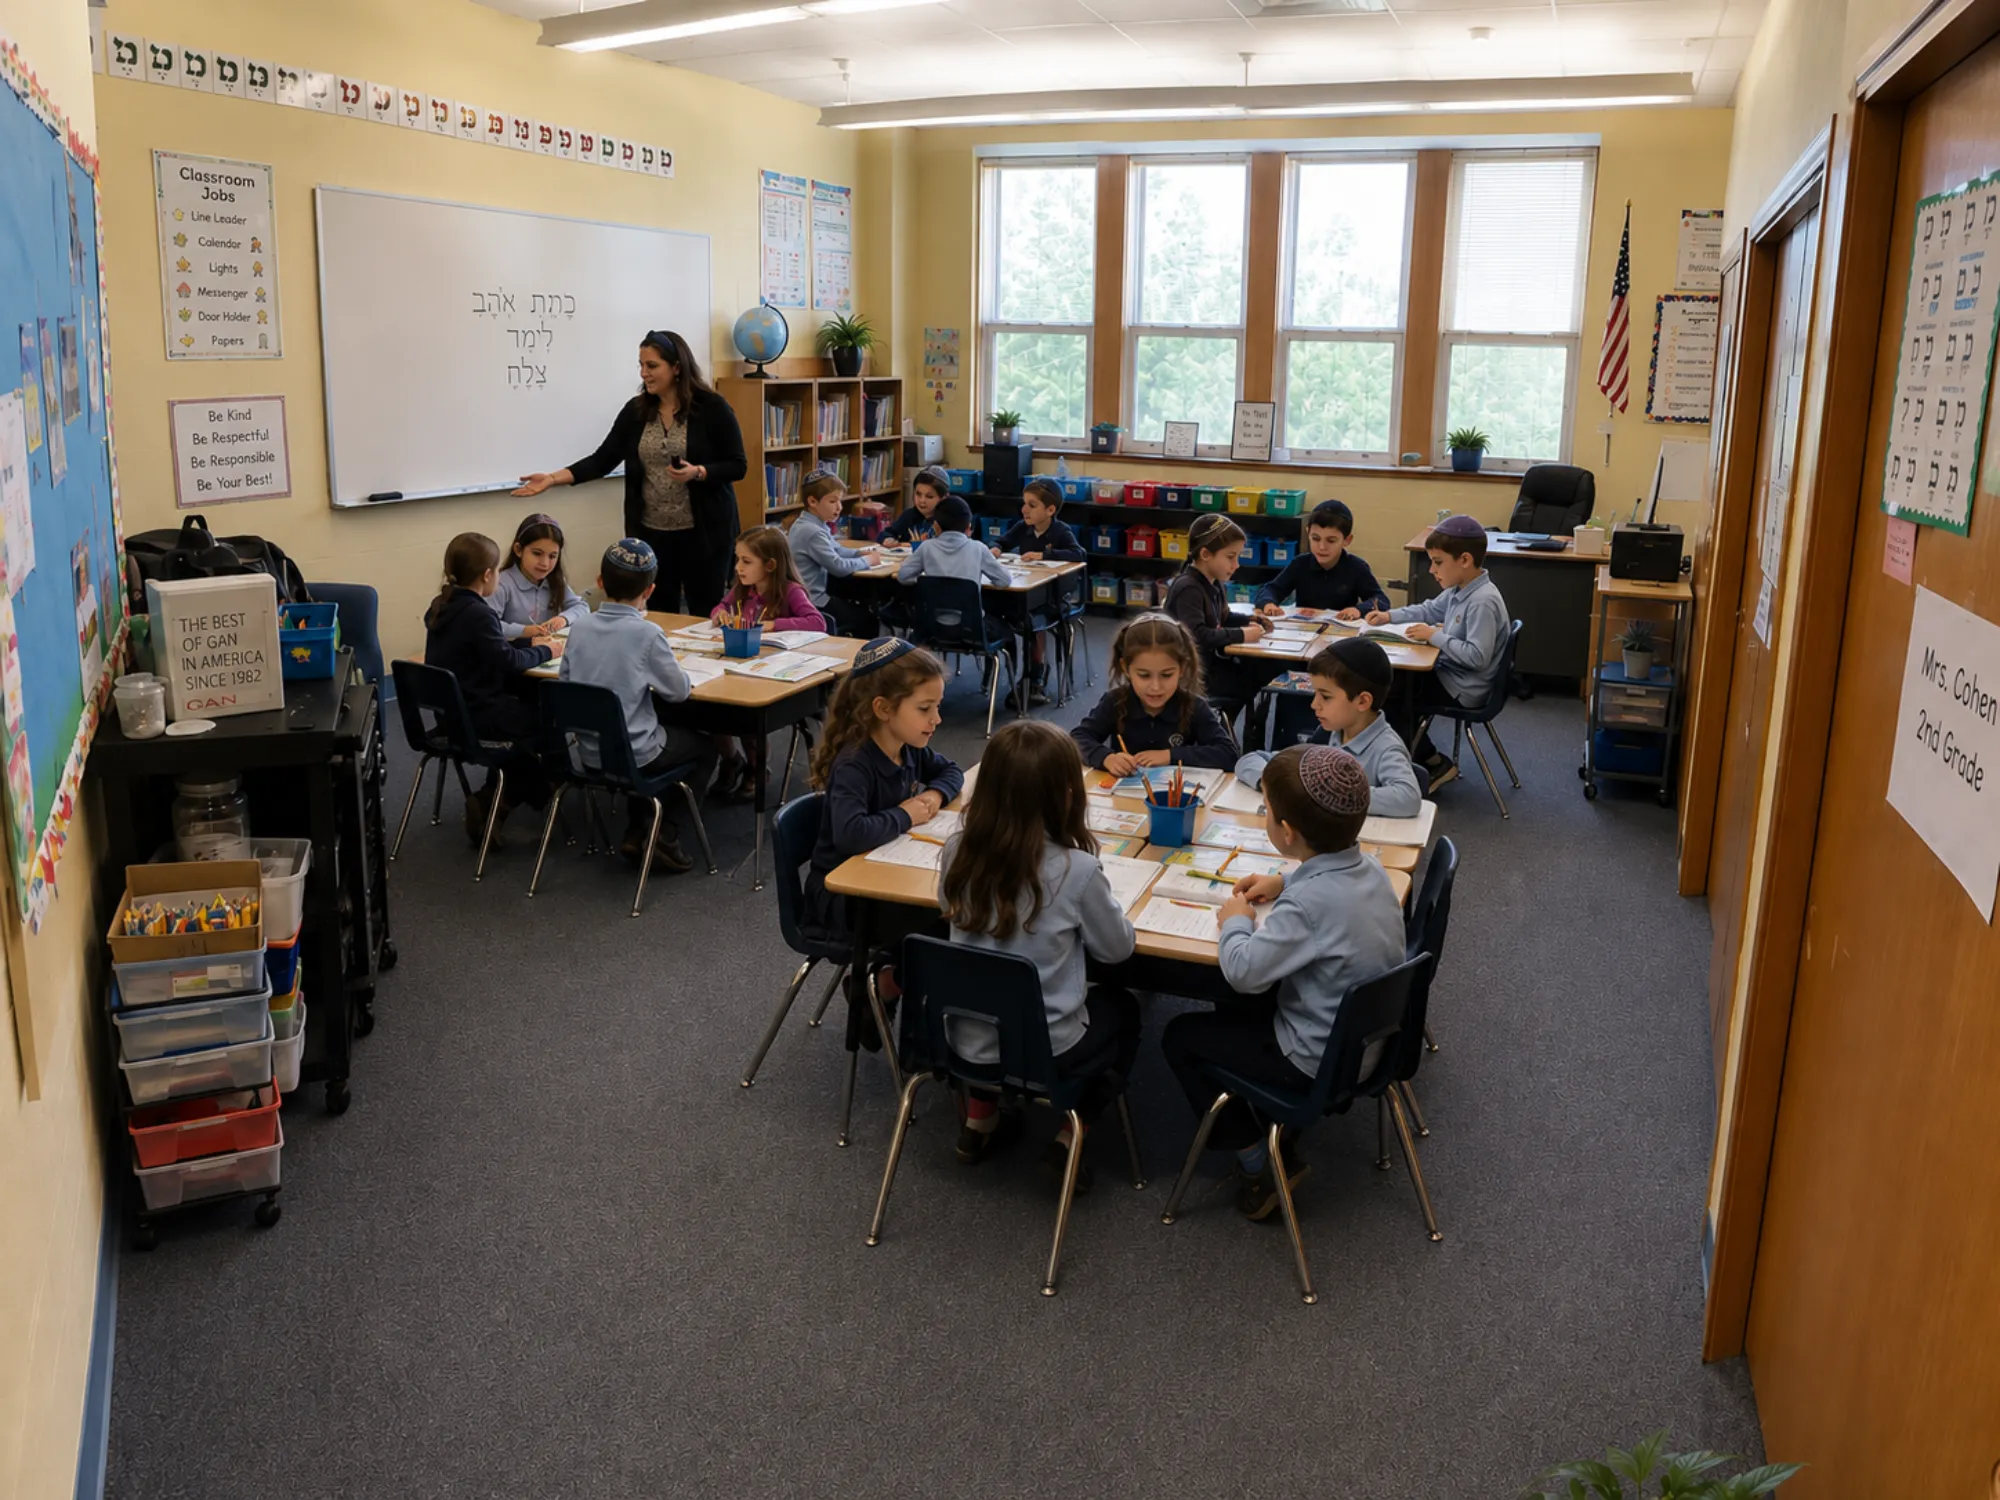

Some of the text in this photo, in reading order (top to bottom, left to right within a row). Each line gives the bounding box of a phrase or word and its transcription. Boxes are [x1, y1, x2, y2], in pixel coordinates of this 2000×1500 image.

[179, 167, 255, 188] Classroom
[201, 187, 236, 203] Jobs
[191, 210, 247, 226] Line Leader
[198, 236, 242, 250] Calendar
[209, 262, 239, 277] Lights
[197, 287, 248, 301] Messenger
[198, 311, 251, 323] Door Holder
[211, 335, 245, 347] Papers
[208, 408, 252, 422] Be Kind
[192, 429, 269, 445] Be Respectful
[191, 451, 275, 469] Be Responsible
[197, 473, 273, 491] Be Your Best!
[179, 612, 246, 633] THE BEST
[182, 633, 238, 652] OF GAN
[181, 650, 264, 671] IN AMERICA
[186, 669, 262, 691] SINCE 1982
[1921, 645, 1997, 727] Mrs. Cohen
[1916, 708, 1985, 793] 2nd Grade
